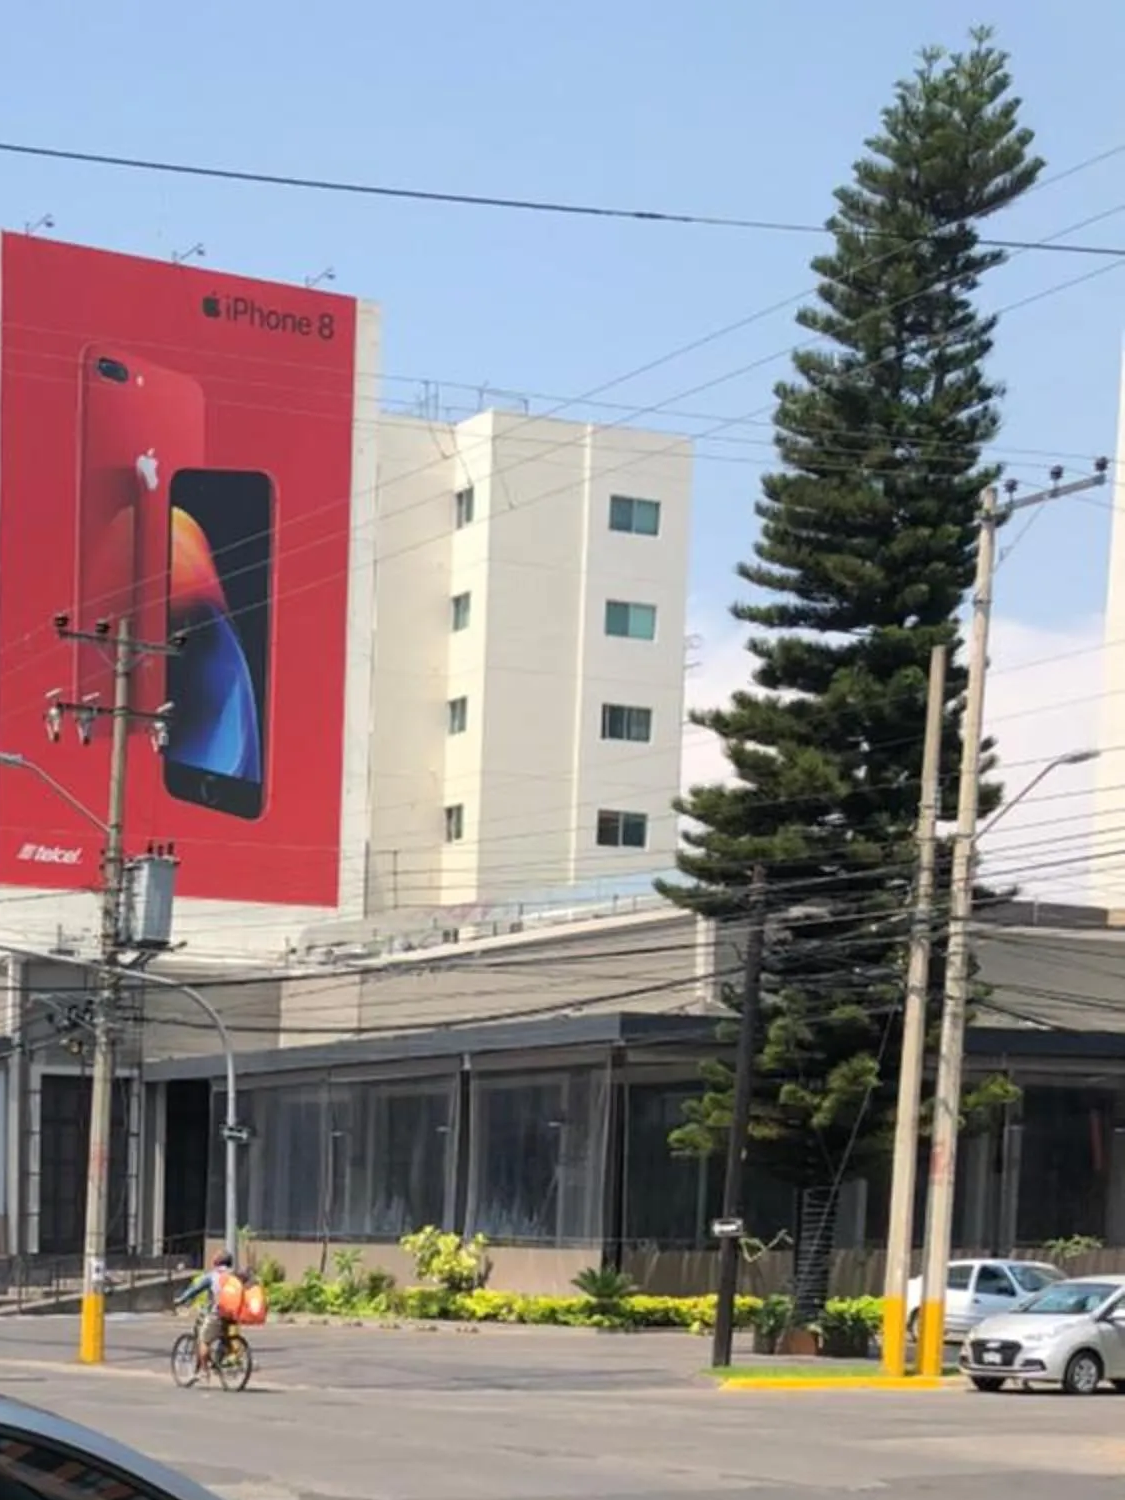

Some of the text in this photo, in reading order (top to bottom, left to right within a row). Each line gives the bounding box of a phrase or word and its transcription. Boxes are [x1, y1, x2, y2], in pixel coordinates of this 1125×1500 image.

[226, 294, 335, 340] iPhone 8
[33, 845, 84, 865] telcel
